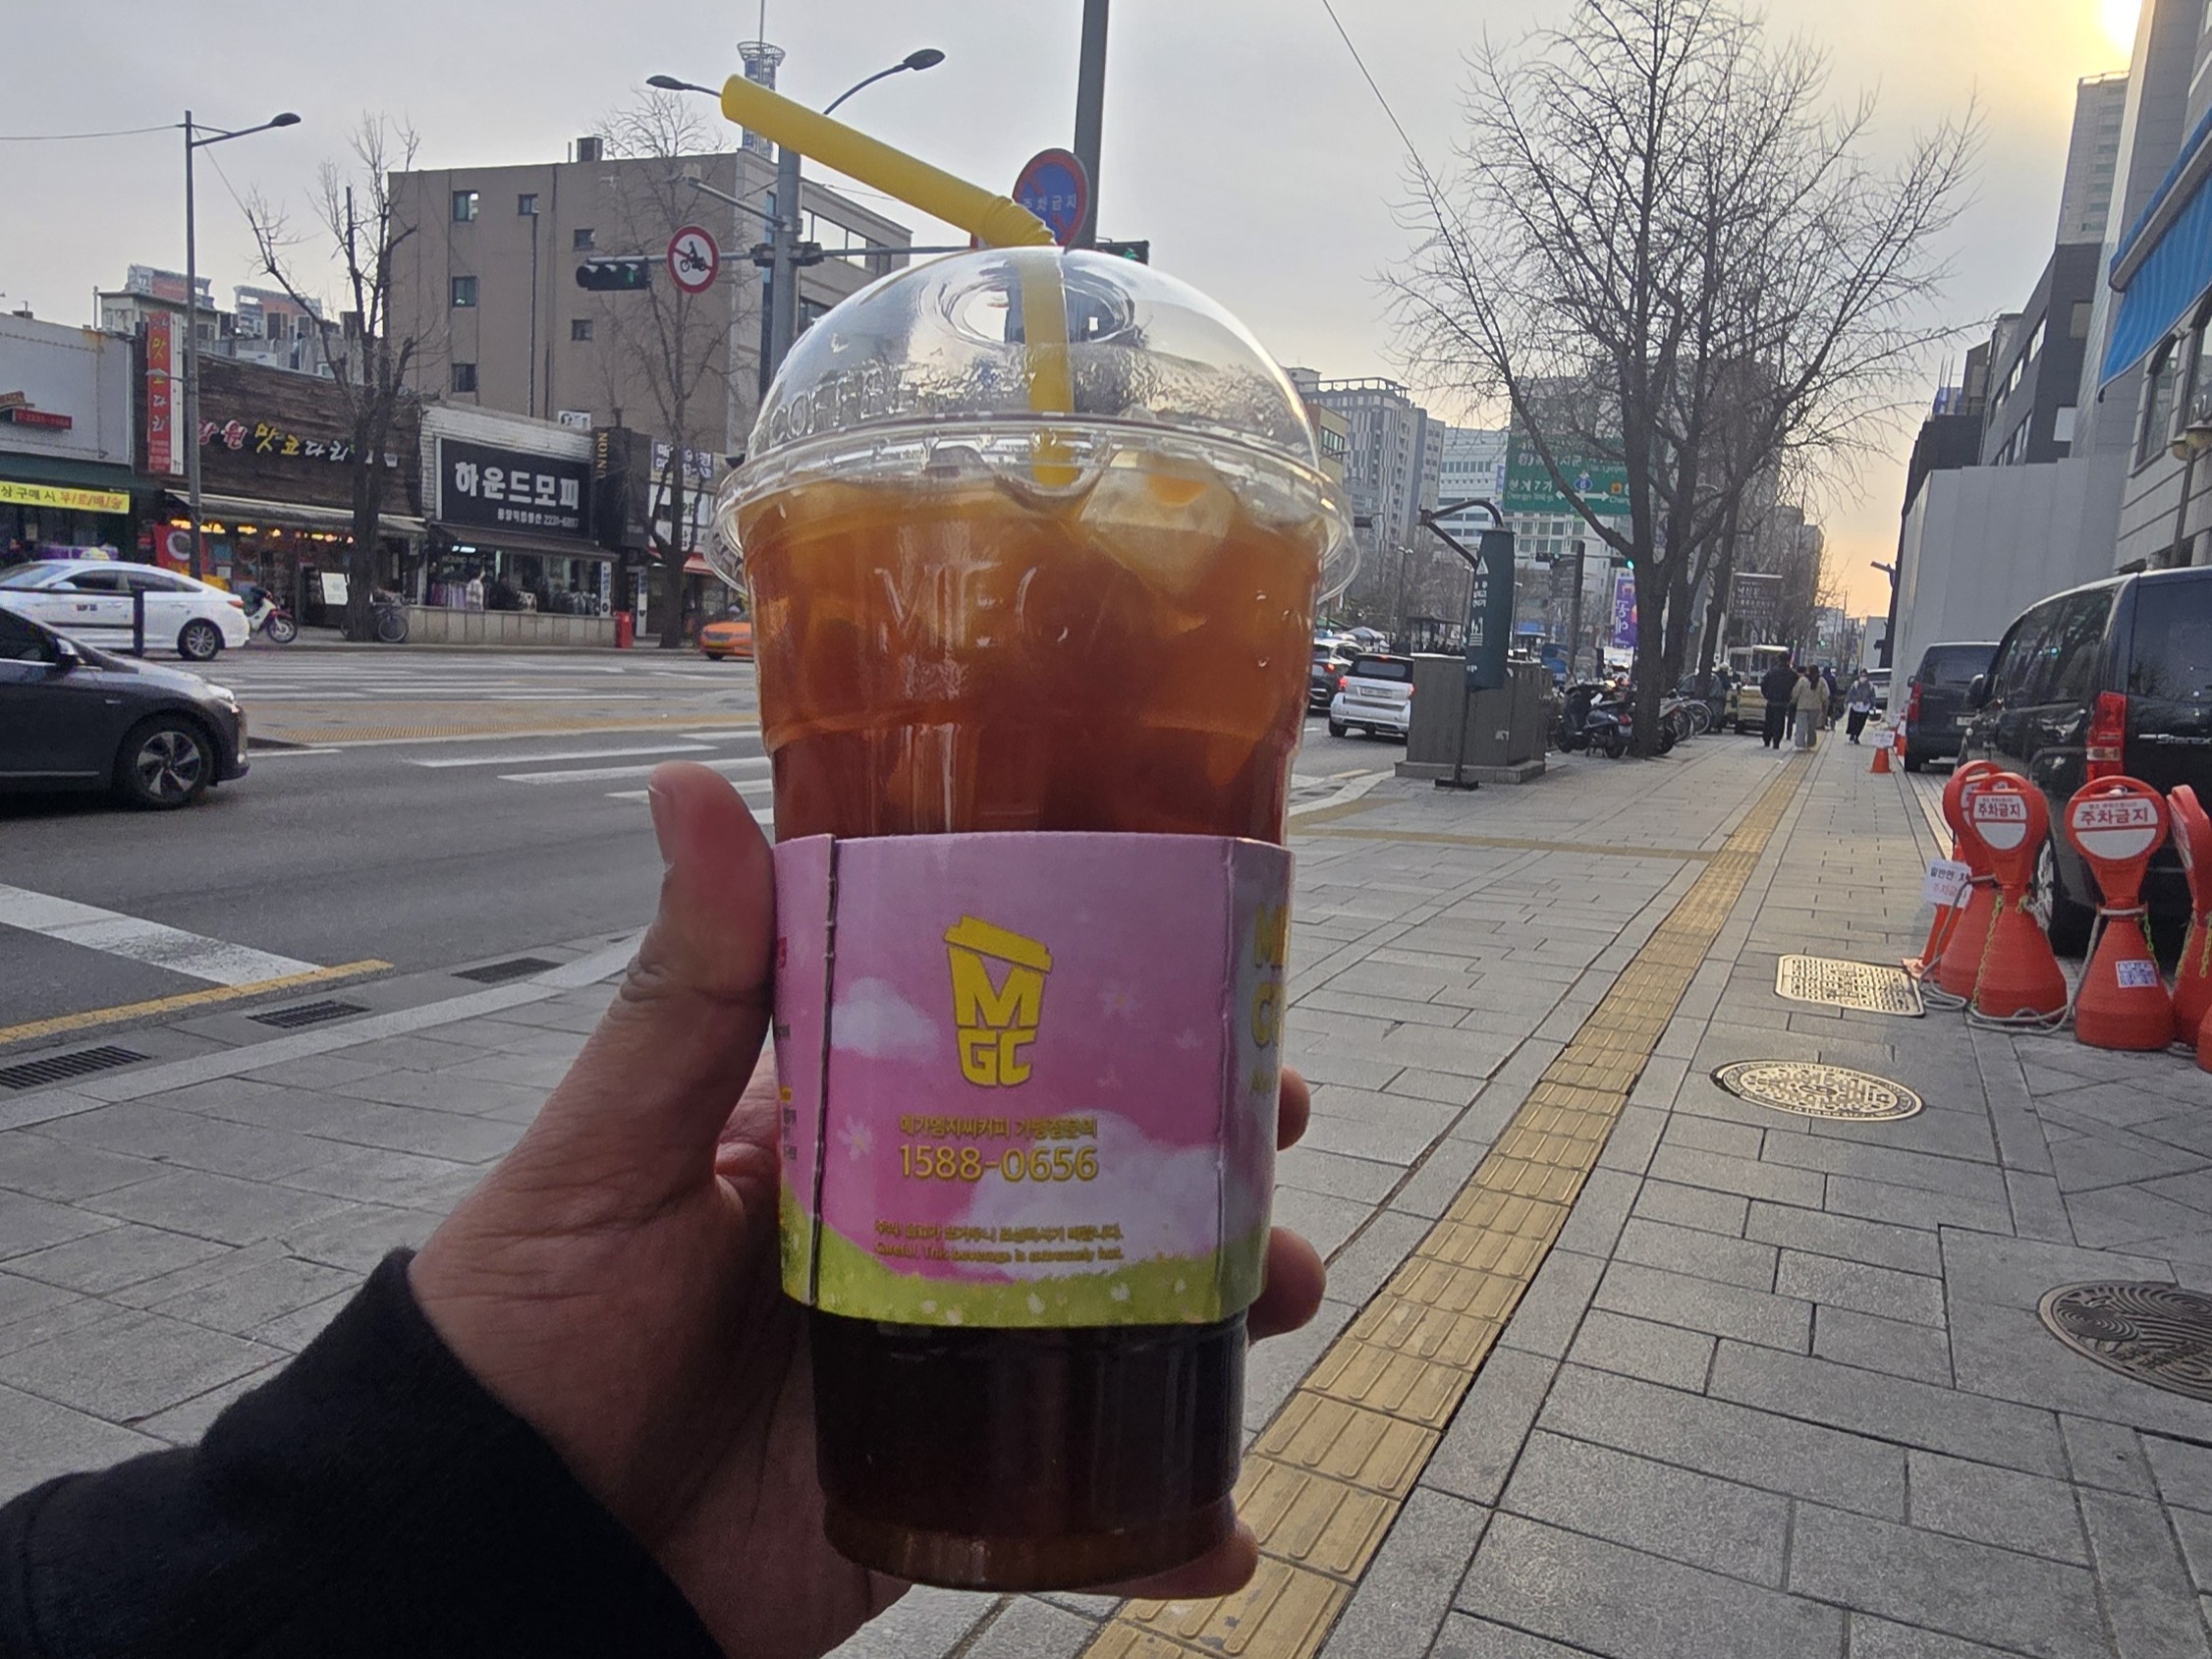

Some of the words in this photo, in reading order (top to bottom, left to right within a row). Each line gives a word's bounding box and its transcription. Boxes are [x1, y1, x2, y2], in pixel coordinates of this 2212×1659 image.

[596, 432, 609, 479] UNION
[455, 462, 580, 511] 하운드모피
[1978, 802, 2020, 817] 주차금지
[2080, 806, 2148, 825] 주차금지
[900, 1115, 1010, 1138] 메가엠지씨커피
[900, 1143, 1099, 1182] 1588-0656
